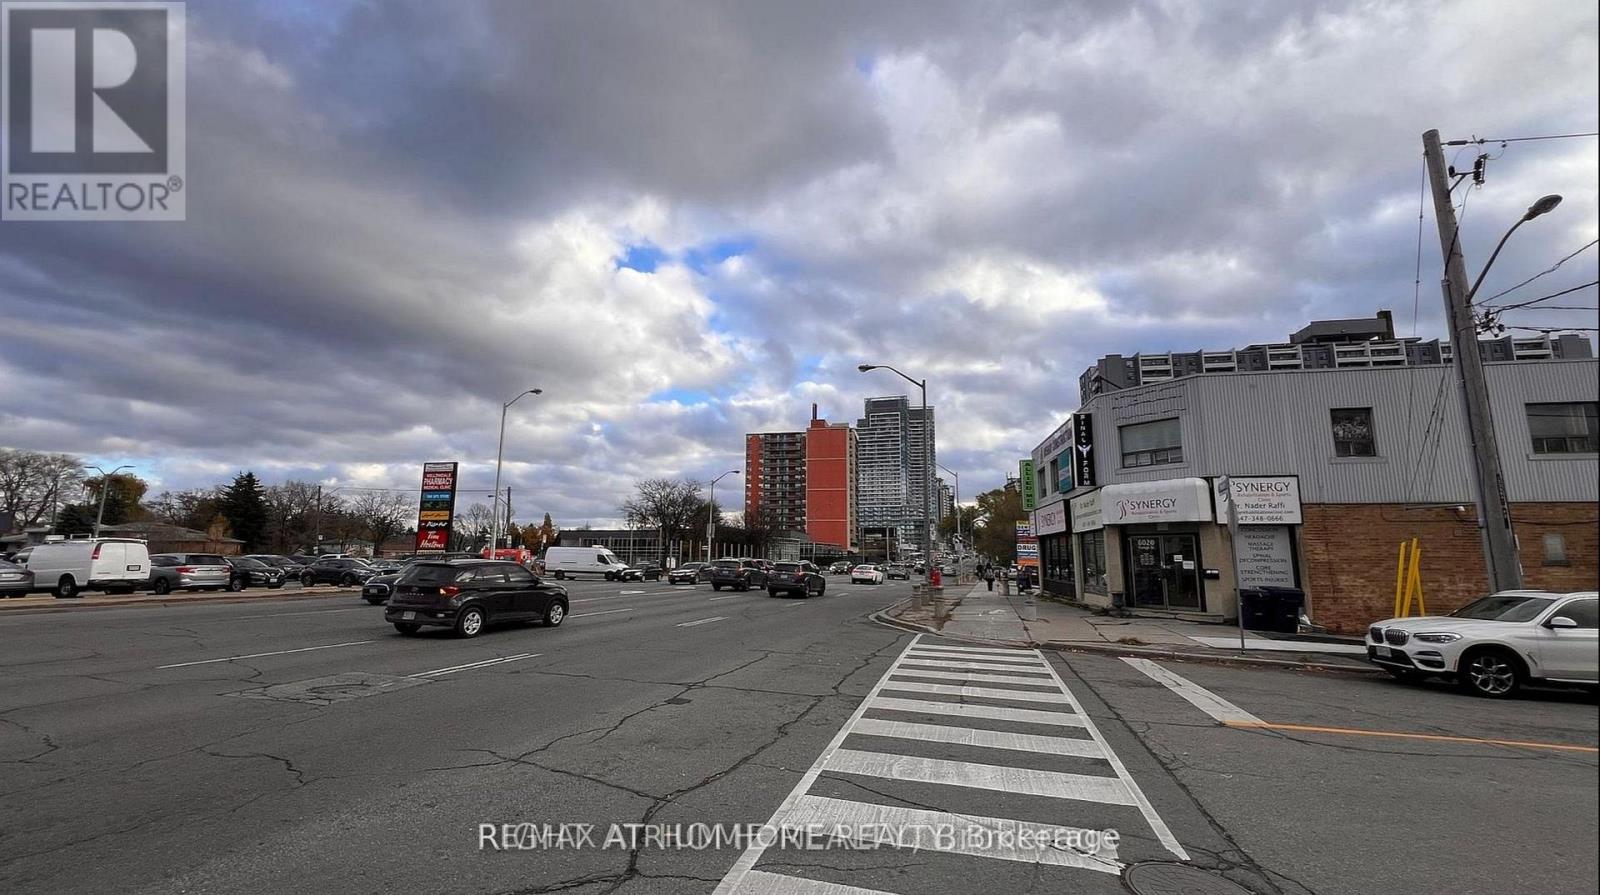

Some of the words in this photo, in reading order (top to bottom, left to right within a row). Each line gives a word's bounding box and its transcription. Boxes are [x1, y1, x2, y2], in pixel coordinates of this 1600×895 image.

[1083, 460, 1091, 486] FORM
[1235, 481, 1291, 492] SYNERGY
[1130, 498, 1177, 510] SYNERGY
[427, 531, 440, 539] Tim
[420, 539, 445, 549] Hortons
